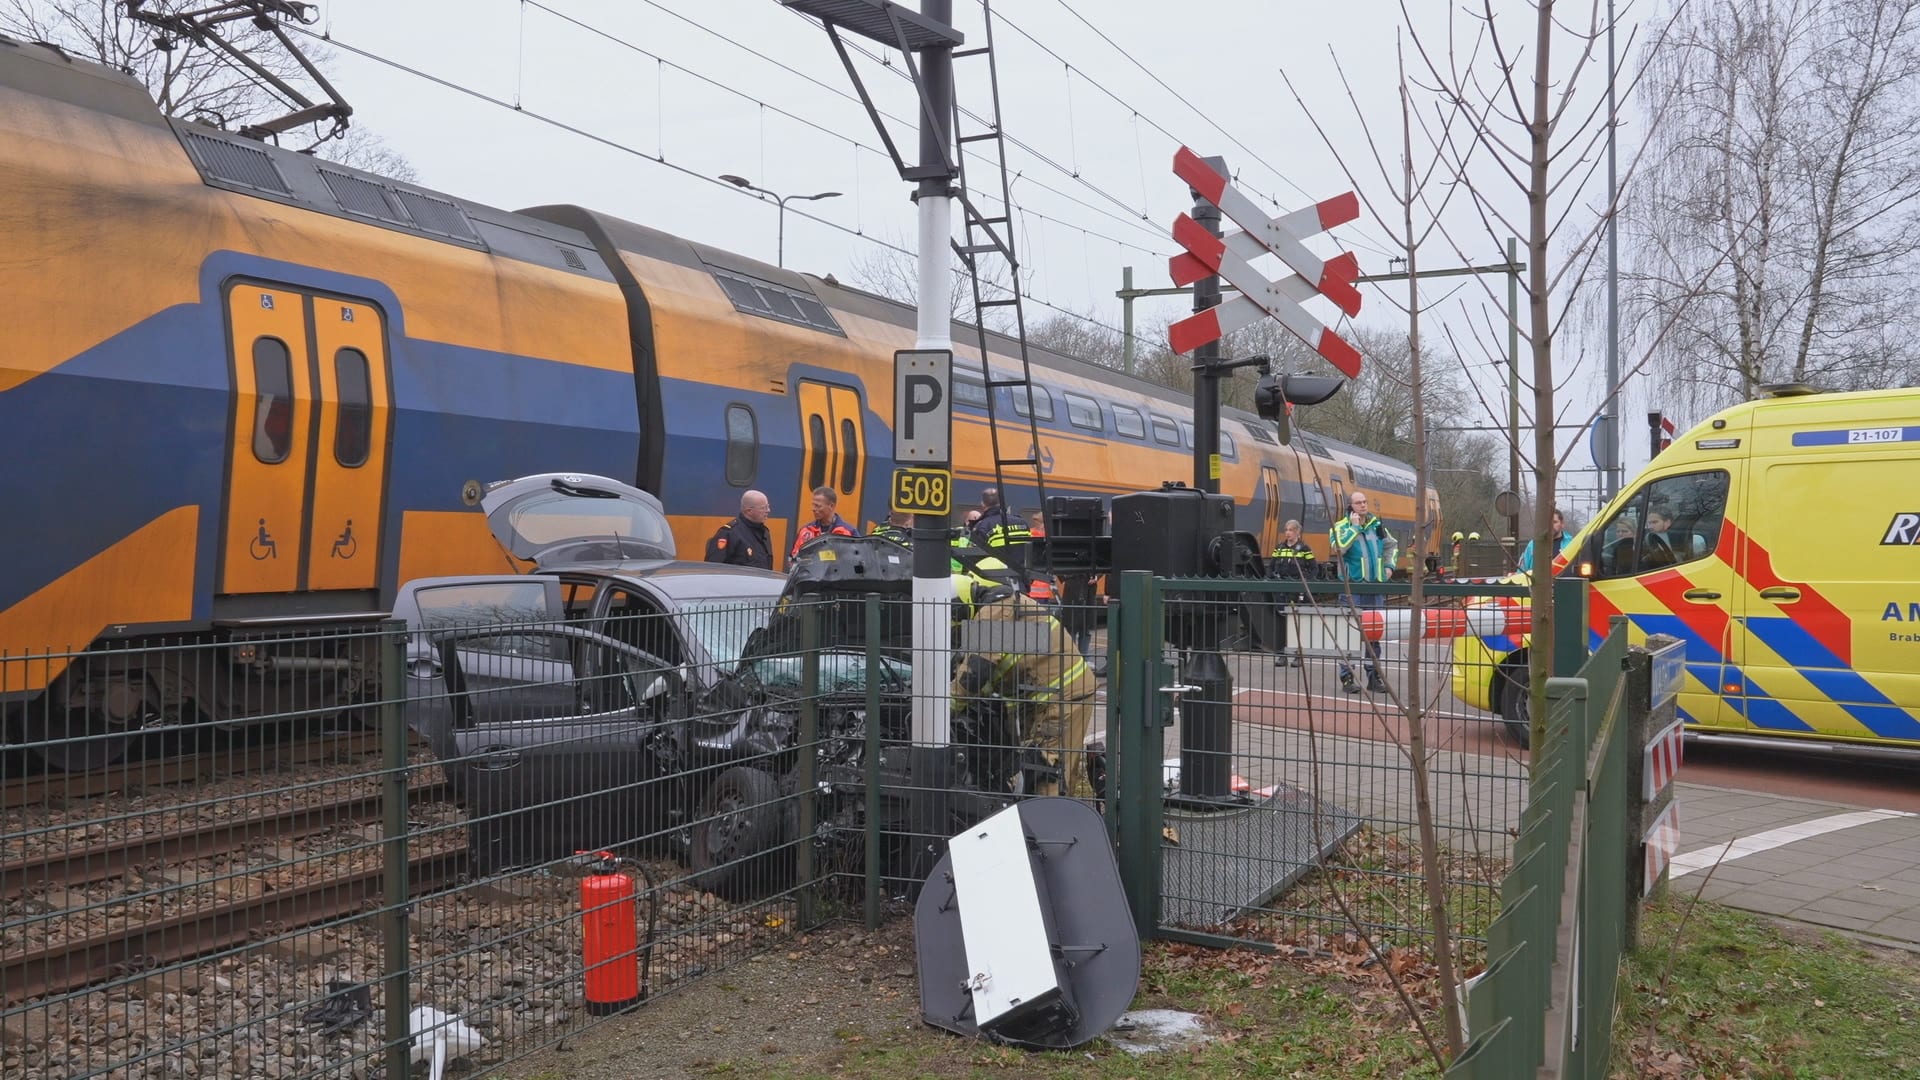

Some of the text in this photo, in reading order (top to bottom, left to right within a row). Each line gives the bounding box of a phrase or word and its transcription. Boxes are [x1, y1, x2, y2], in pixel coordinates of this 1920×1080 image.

[904, 375, 943, 440] P
[1852, 430, 1898, 441] 21-107
[900, 475, 944, 507] 508
[1884, 513, 1920, 544] R
